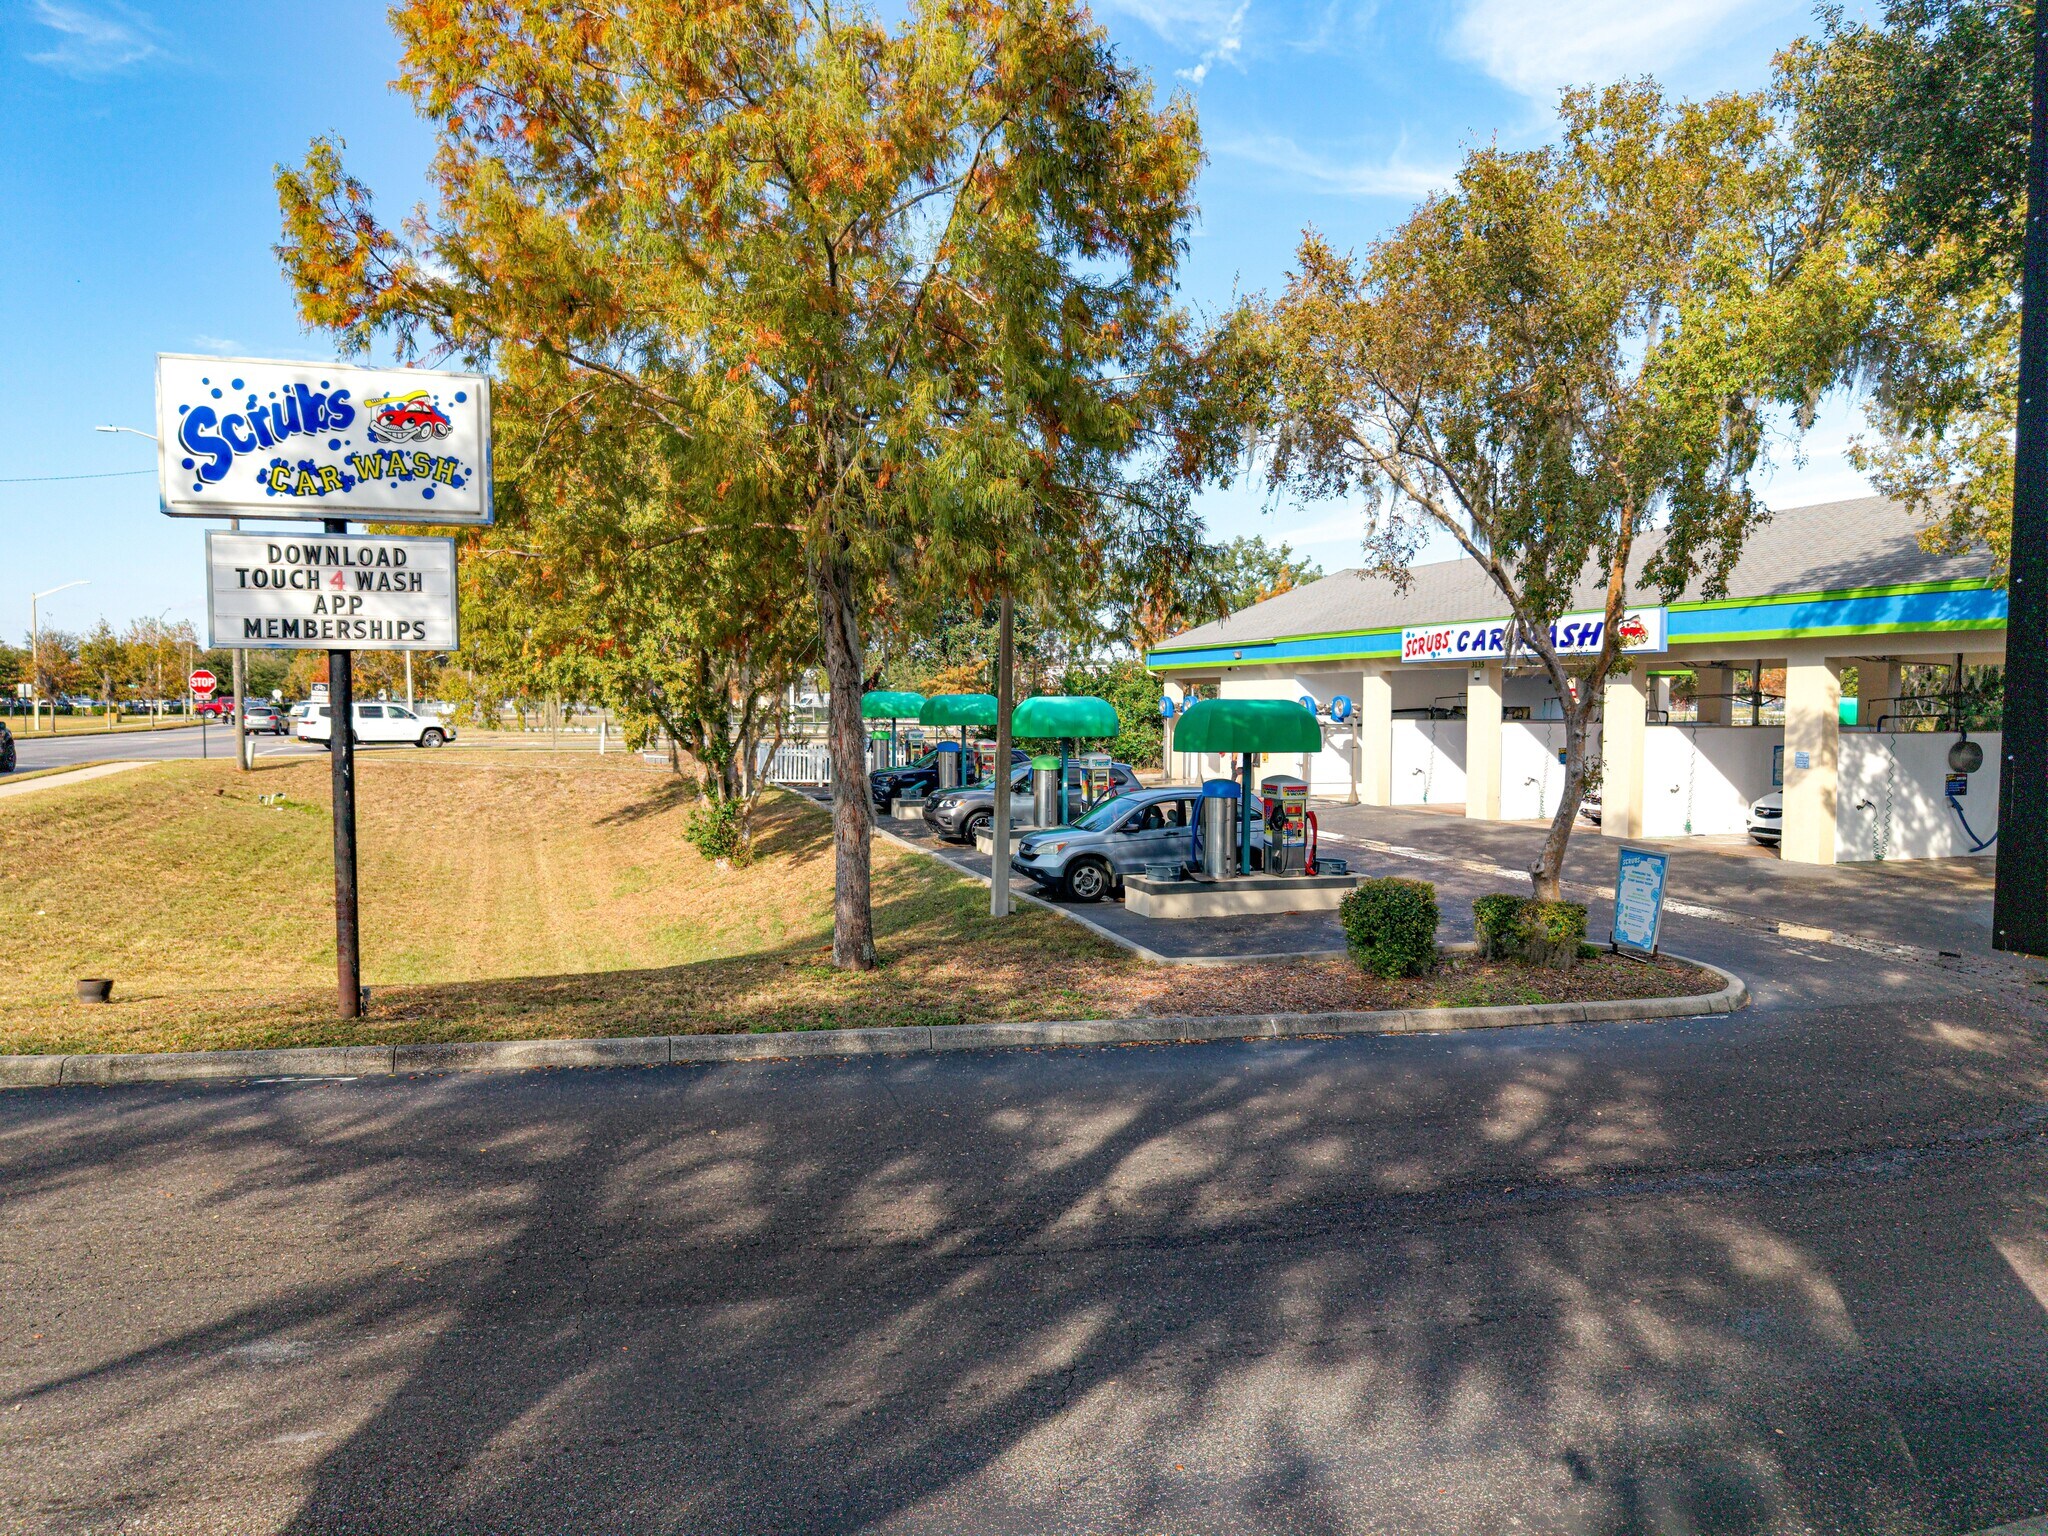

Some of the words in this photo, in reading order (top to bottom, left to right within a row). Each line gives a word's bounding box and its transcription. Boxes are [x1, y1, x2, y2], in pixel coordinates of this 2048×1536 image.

[179, 384, 355, 484] Scrubs
[269, 464, 343, 496] CAR
[352, 449, 456, 486] WASH
[267, 543, 407, 568] DOWNLOAD
[235, 567, 320, 590] TOUCH
[329, 570, 346, 591] 4
[355, 571, 423, 592] WASH
[313, 594, 364, 615] APP
[243, 617, 426, 641] MEMBERSHIPS
[1404, 630, 1451, 658] SCRUBS
[1456, 628, 1505, 653] CAR
[191, 677, 215, 687] STOP
